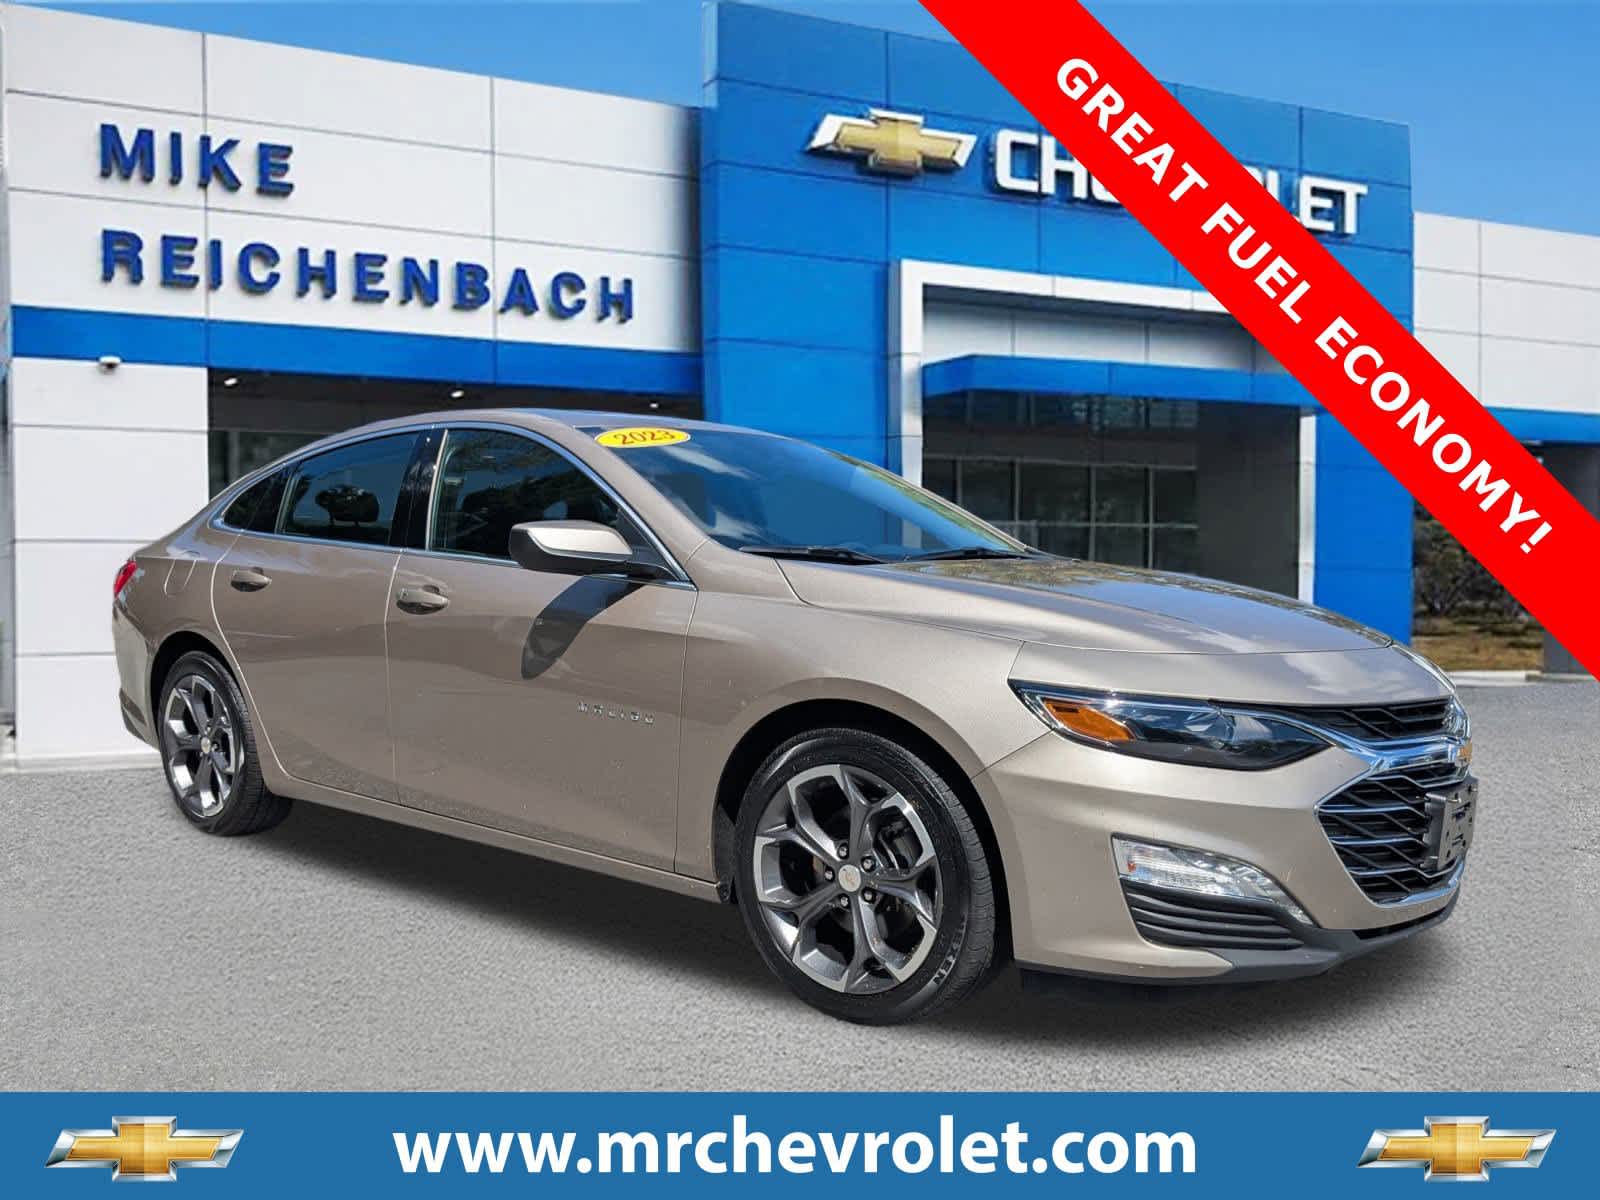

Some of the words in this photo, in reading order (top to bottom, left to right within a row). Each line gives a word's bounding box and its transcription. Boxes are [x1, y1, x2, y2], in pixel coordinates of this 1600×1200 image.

[99, 123, 294, 195] MIKE
[101, 229, 634, 321] REICHENBACH
[614, 430, 675, 445] 2023
